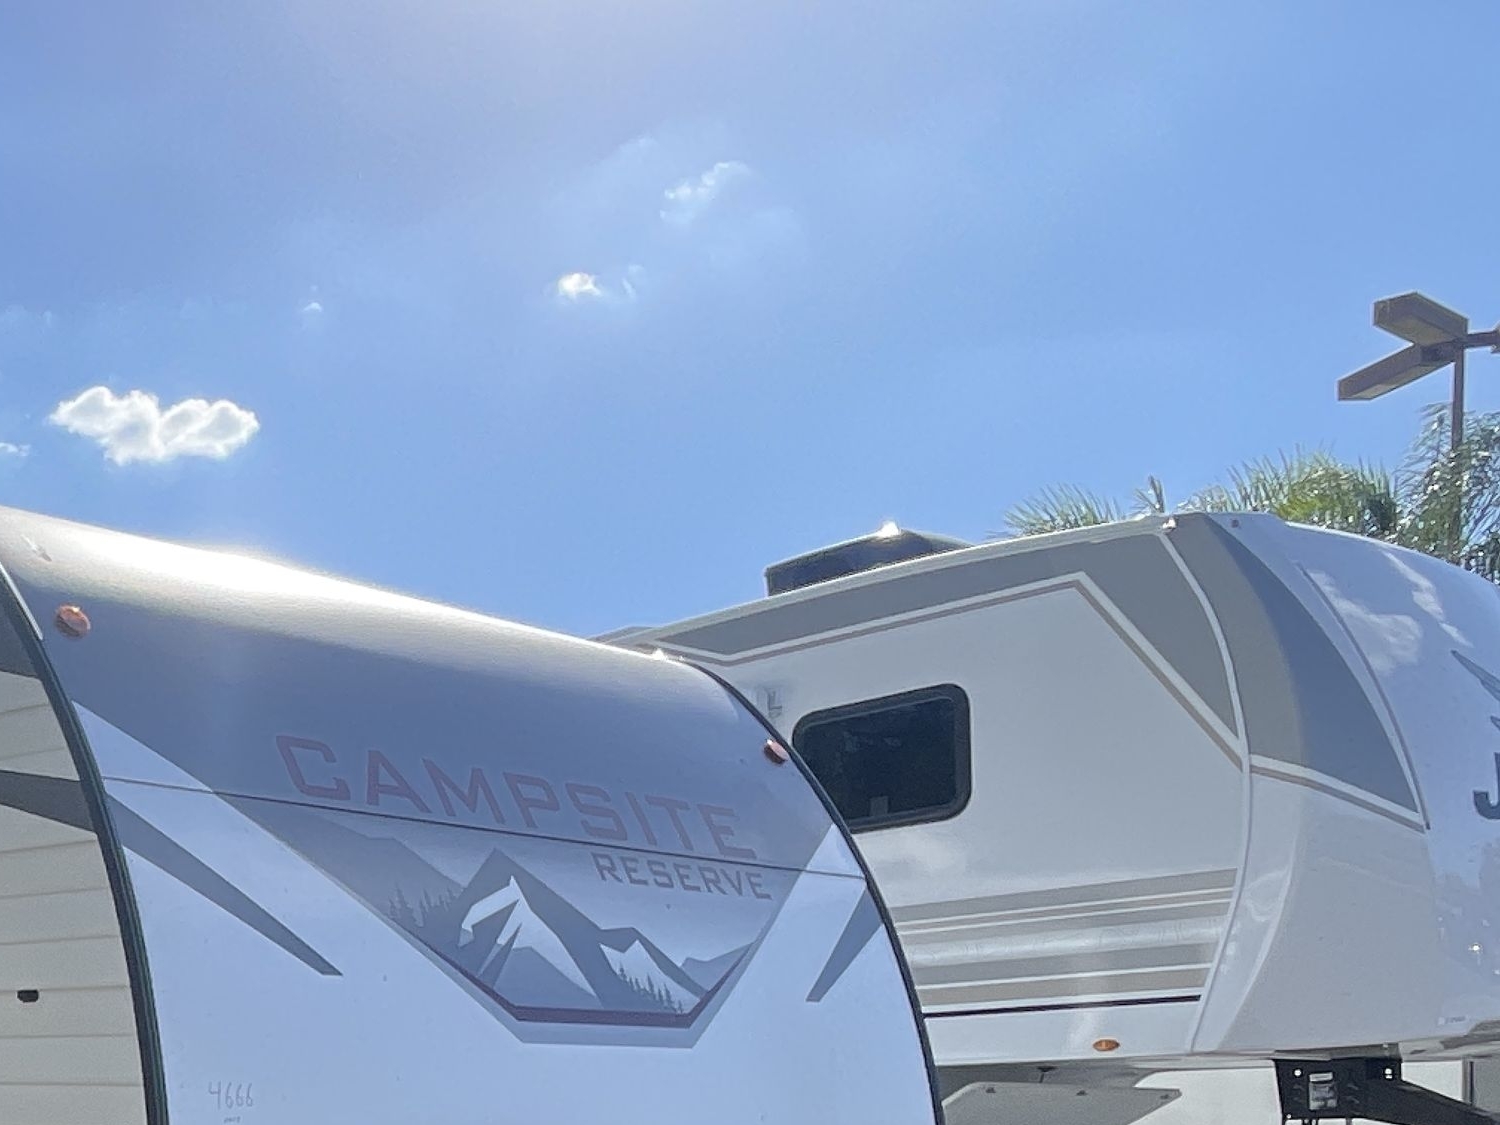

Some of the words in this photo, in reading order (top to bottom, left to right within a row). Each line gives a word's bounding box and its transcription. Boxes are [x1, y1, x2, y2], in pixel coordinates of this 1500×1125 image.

[275, 735, 758, 860] CAMPSITE
[592, 853, 772, 900] RESERVE
[207, 1080, 253, 1111] 4666
